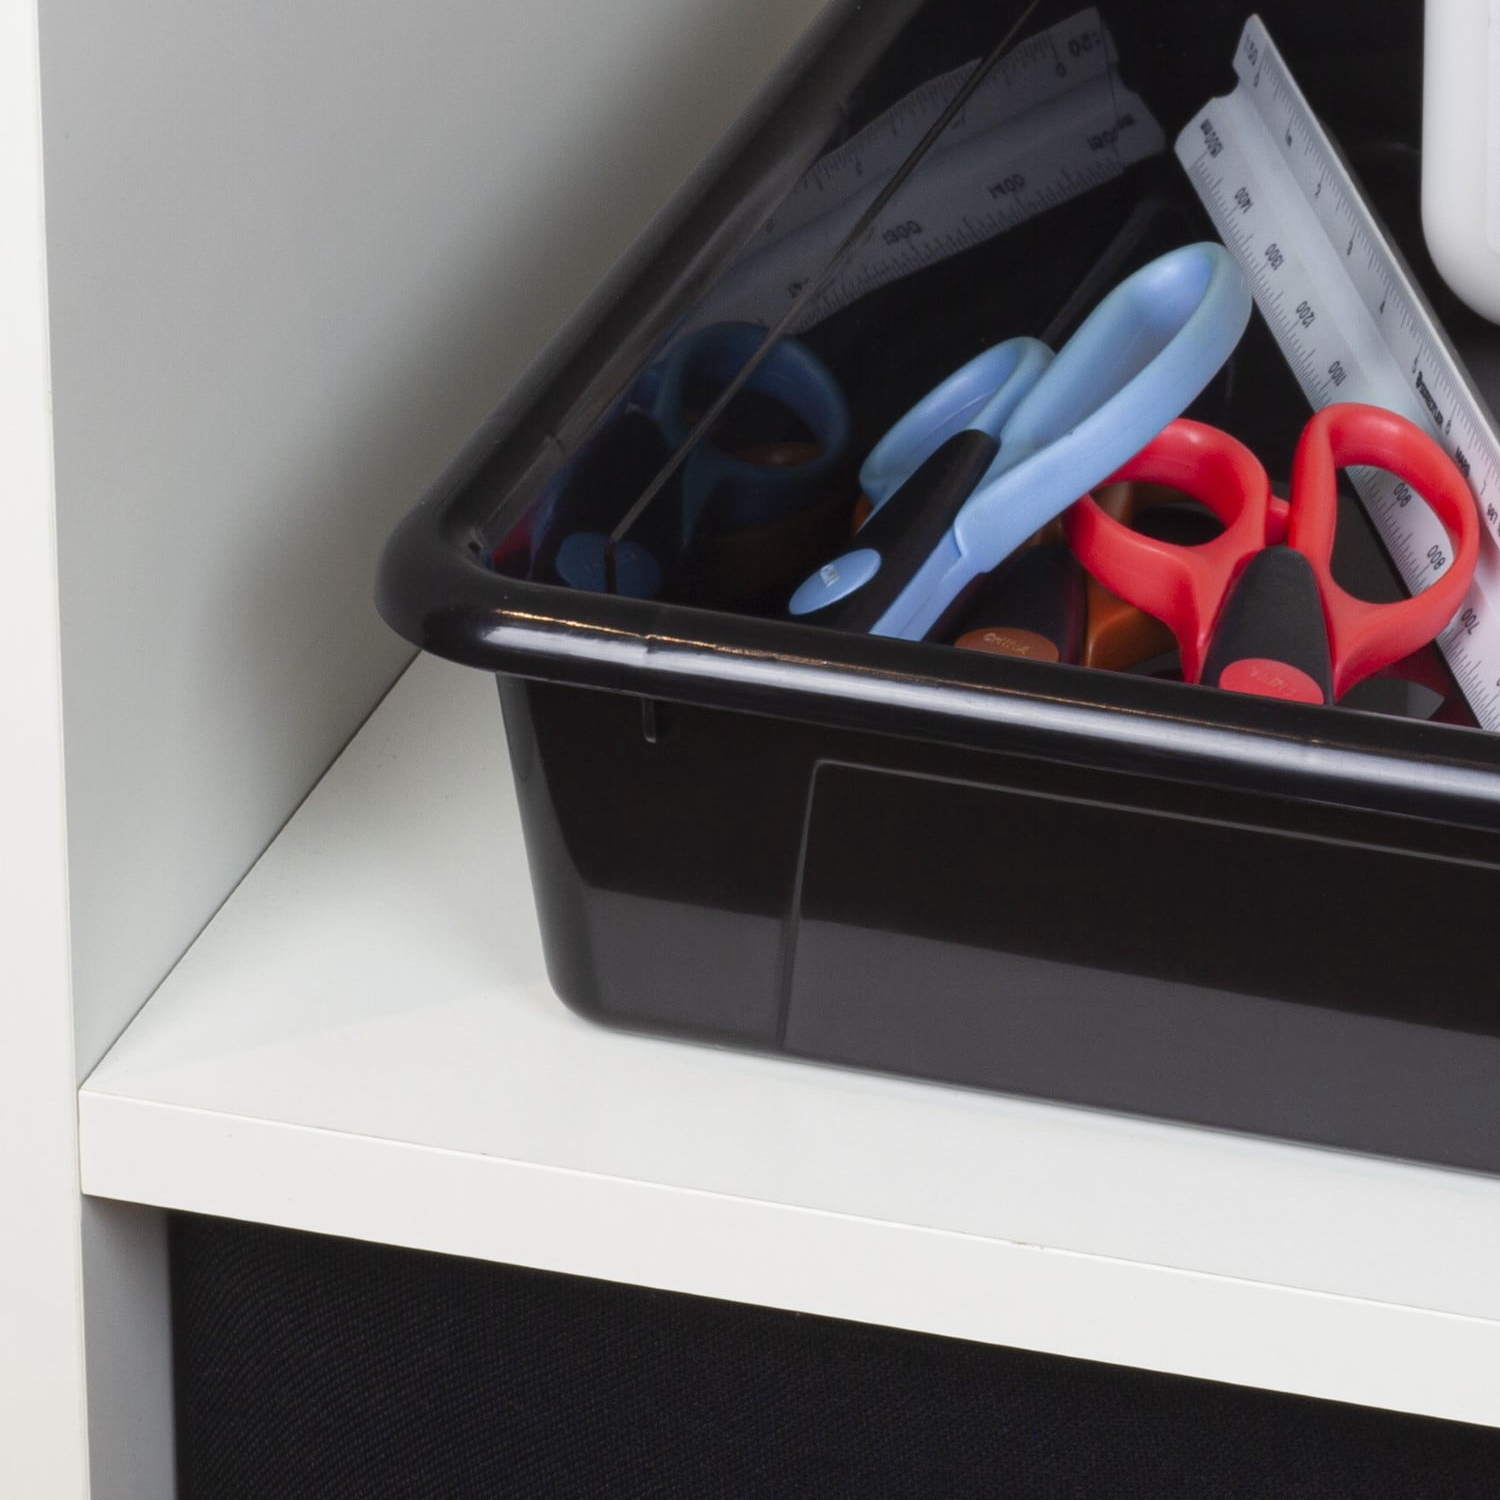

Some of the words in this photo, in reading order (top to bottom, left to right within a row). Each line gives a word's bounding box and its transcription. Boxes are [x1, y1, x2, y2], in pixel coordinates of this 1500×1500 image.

[1233, 186, 1254, 215] 1400
[1264, 242, 1285, 271] 1300
[1295, 300, 1316, 329] 1200
[1327, 360, 1348, 388] 1100
[1393, 481, 1413, 509] 900
[1426, 543, 1447, 571] 800
[1461, 607, 1481, 636] 700
